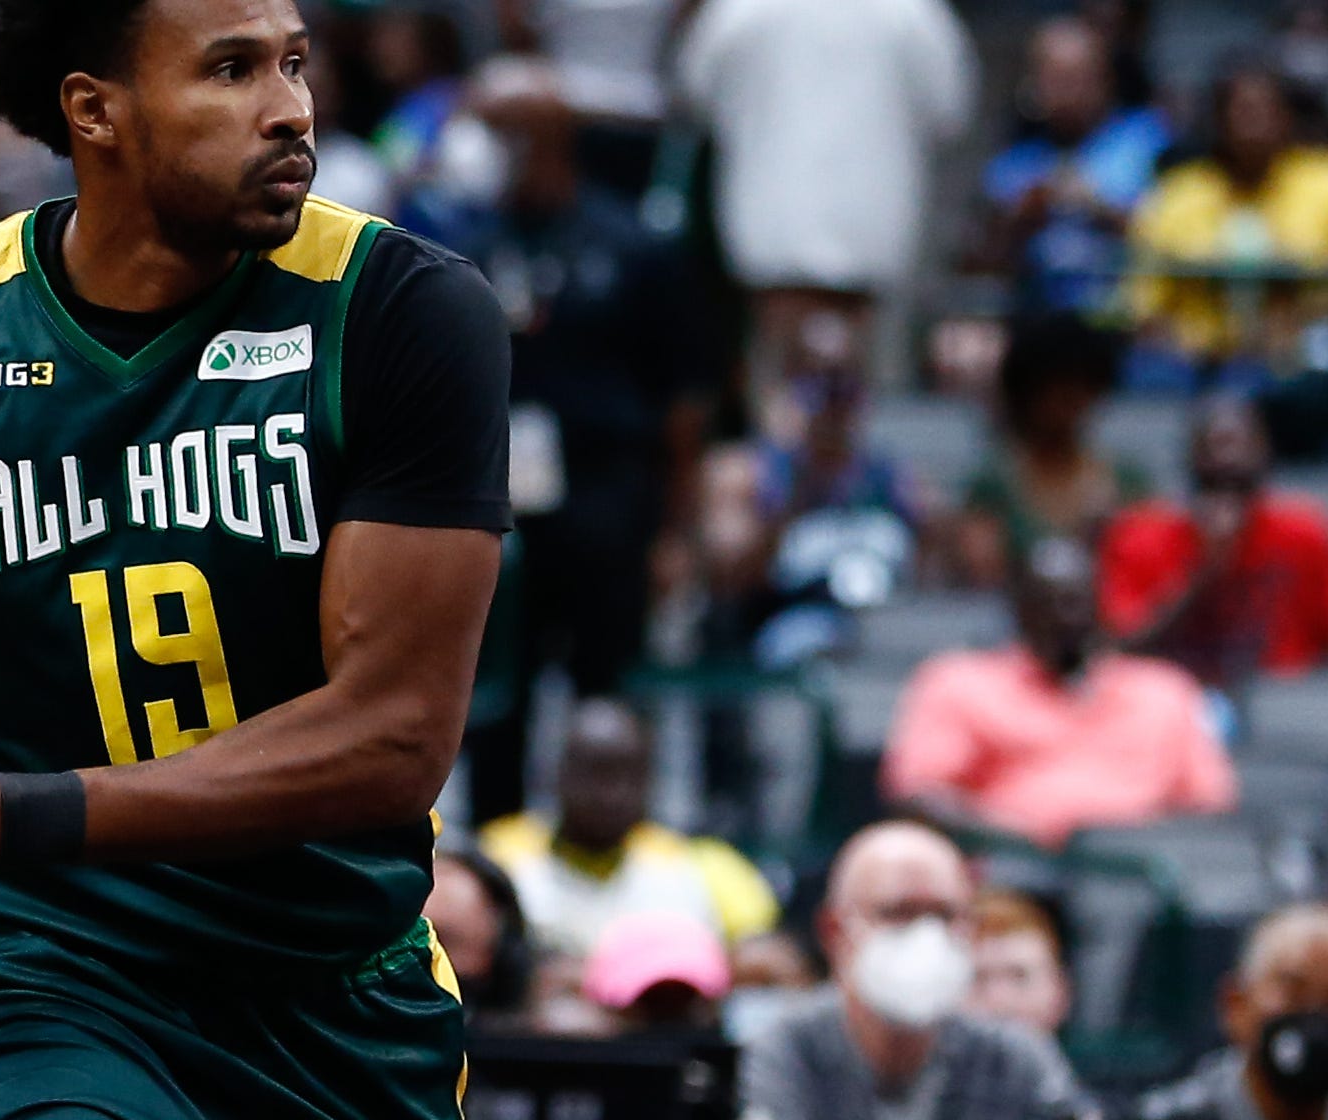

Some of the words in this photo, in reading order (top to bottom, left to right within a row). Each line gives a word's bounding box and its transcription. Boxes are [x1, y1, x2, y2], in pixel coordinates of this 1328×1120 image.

[241, 337, 306, 367] XBOX
[125, 412, 321, 558] HOGS
[69, 561, 239, 766] 19
